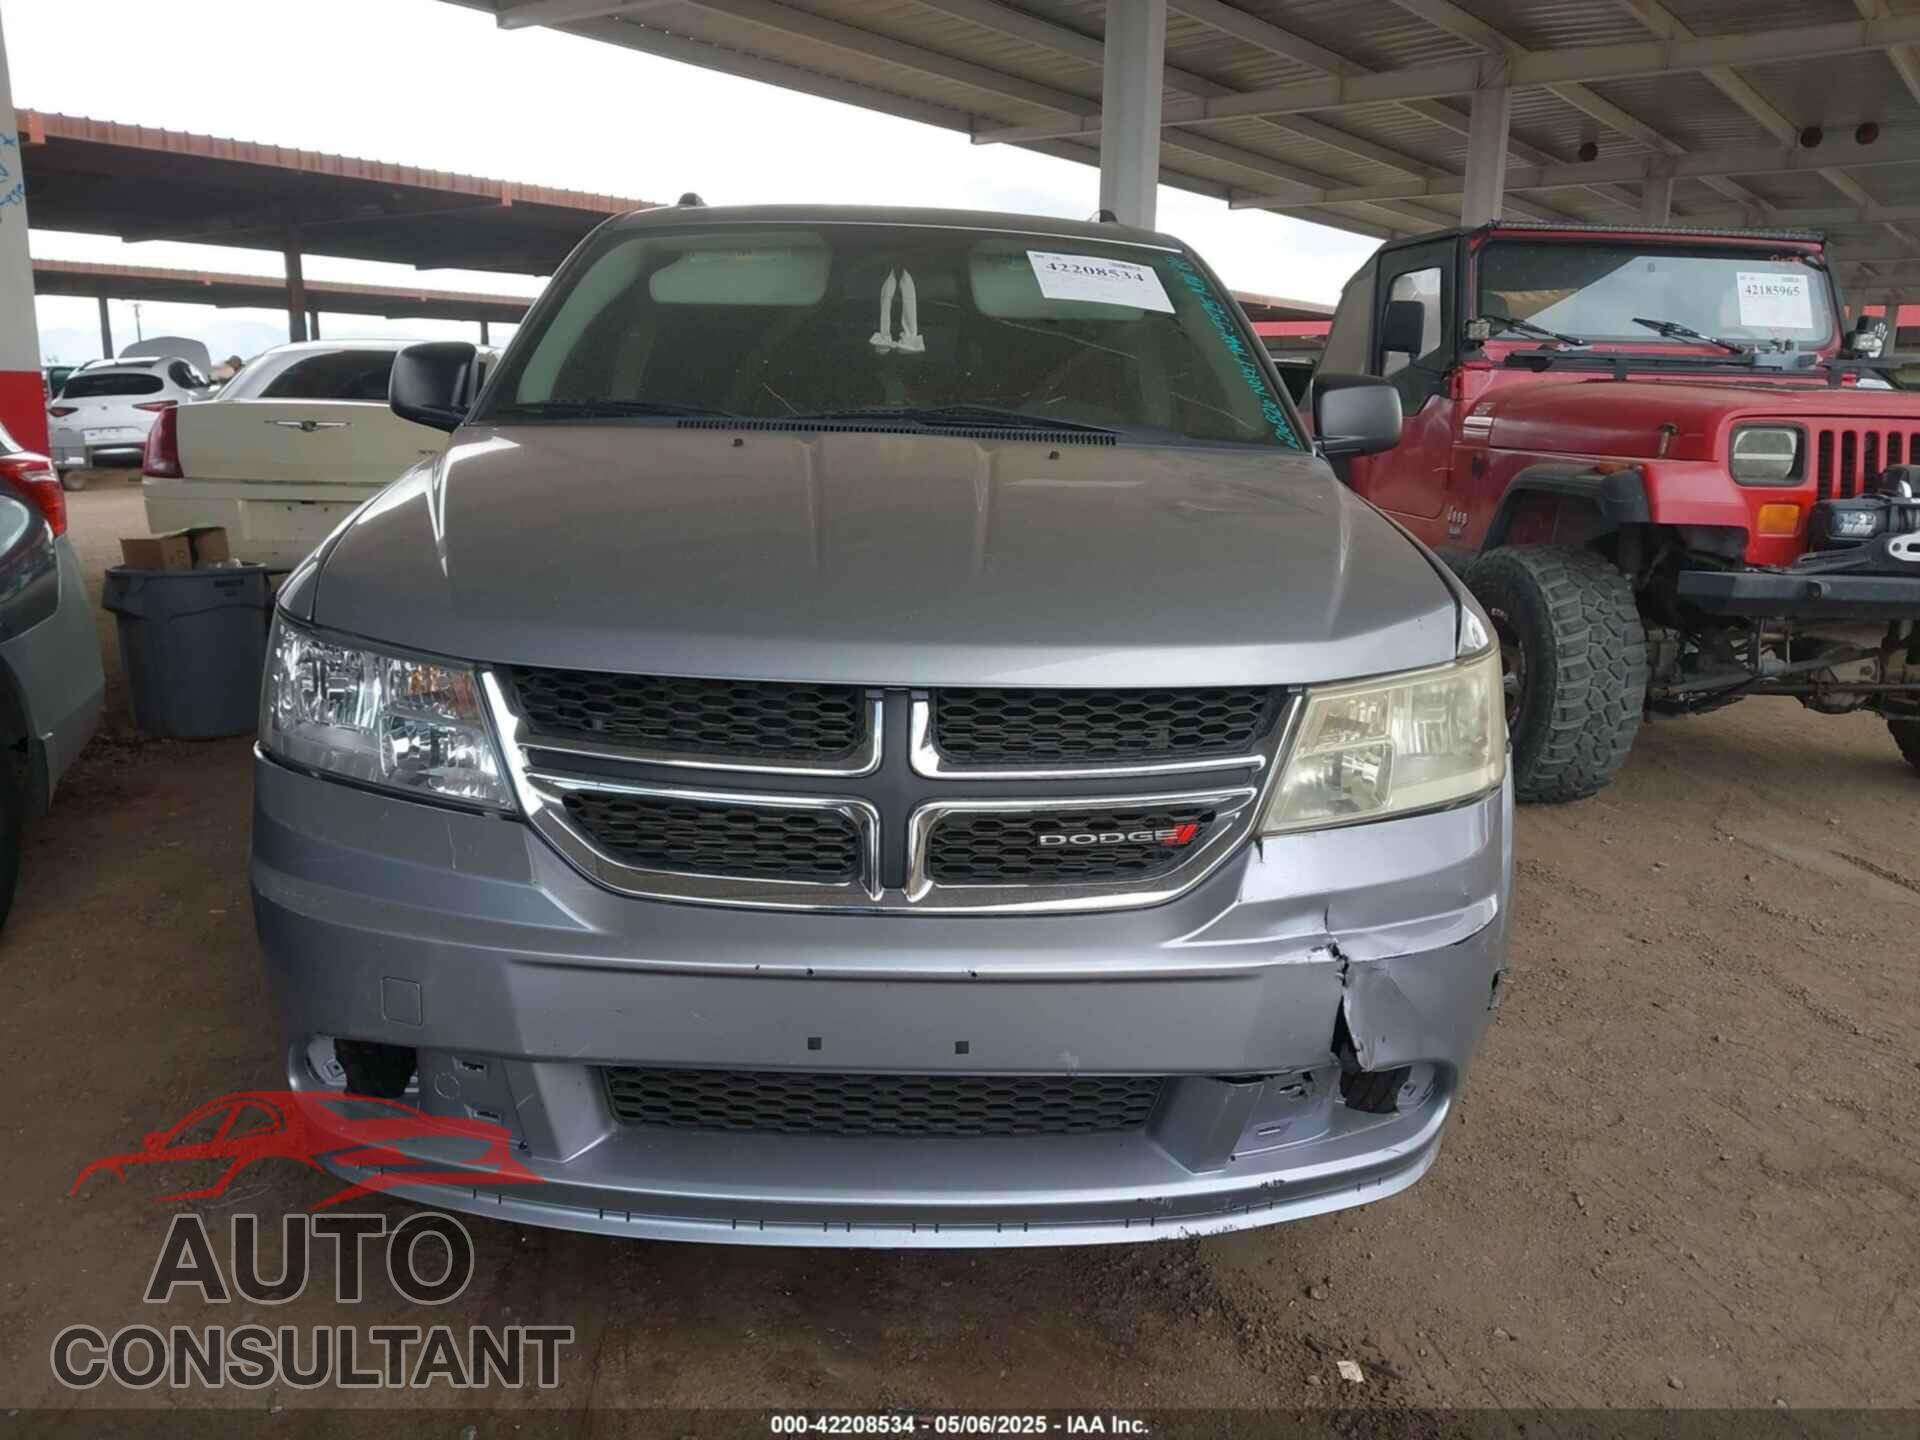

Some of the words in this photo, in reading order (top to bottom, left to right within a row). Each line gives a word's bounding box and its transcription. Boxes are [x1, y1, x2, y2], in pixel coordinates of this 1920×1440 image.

[1046, 262, 1145, 282] 42208534
[1744, 284, 1801, 297] 42185965
[1039, 829, 1178, 846] DODGE
